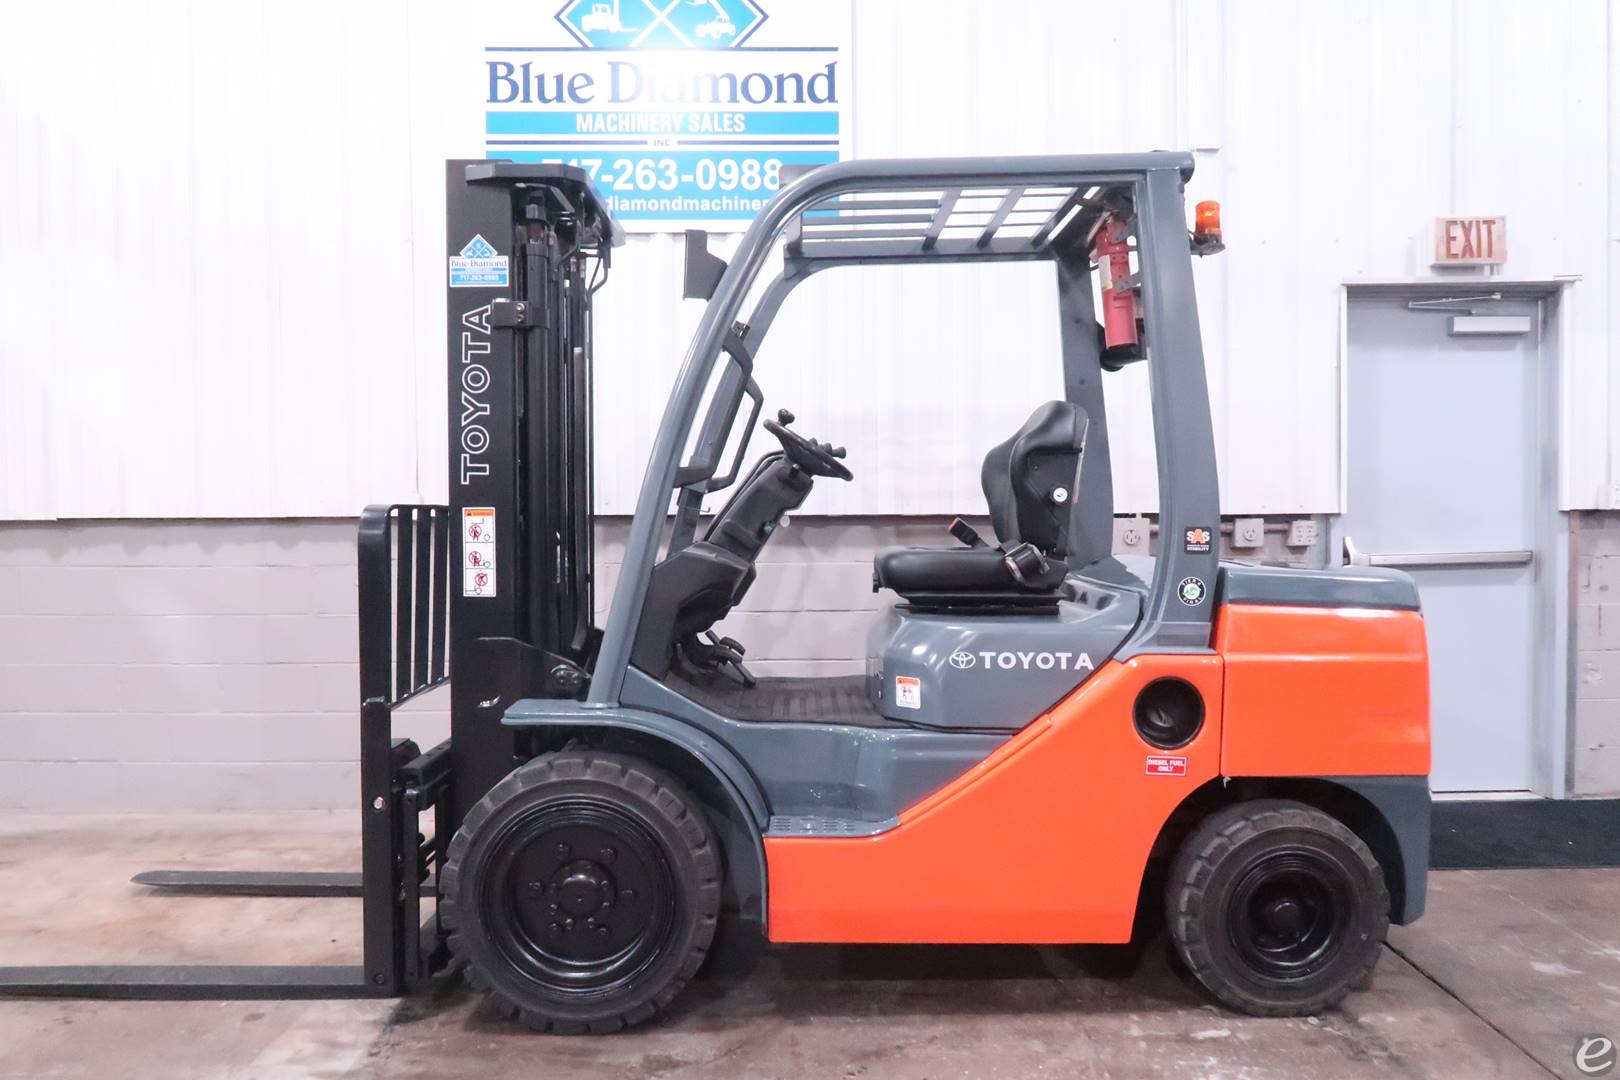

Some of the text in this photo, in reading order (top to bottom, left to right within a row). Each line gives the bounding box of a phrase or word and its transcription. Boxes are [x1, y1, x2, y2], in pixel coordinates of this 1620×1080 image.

[486, 61, 839, 104] Blue Diamond
[576, 113, 746, 133] MACHINERY SALES
[541, 158, 783, 191] 7-263-0988
[1445, 219, 1496, 259] EXIT
[461, 304, 491, 484] TOYOTA
[1186, 528, 1210, 544] SAS
[979, 651, 1094, 670] TOYOTA
